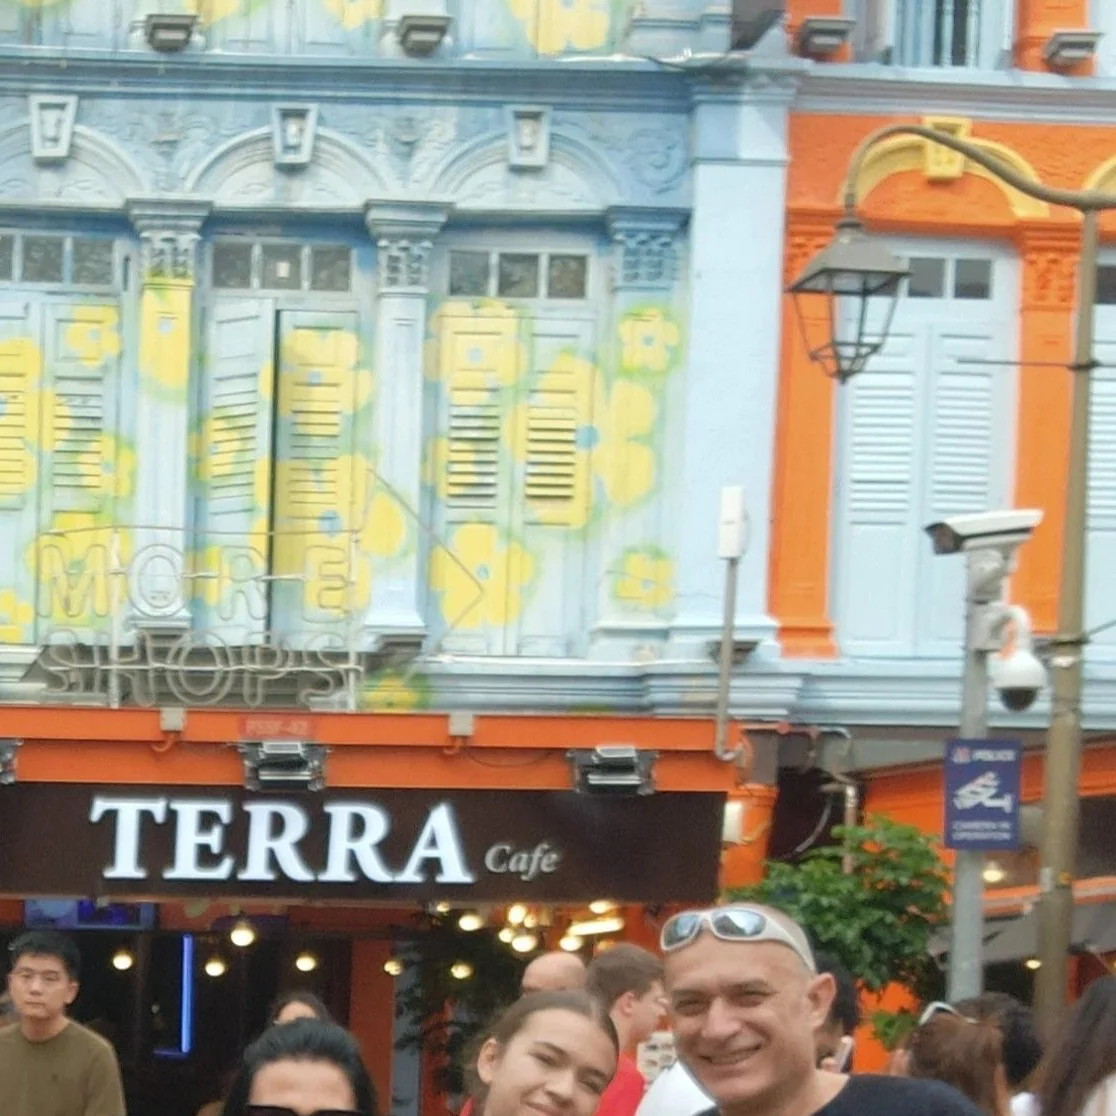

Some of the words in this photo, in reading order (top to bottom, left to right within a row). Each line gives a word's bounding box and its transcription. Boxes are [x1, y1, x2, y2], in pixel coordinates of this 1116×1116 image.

[35, 543, 351, 623] MORE
[38, 628, 348, 707] SHOPS
[90, 796, 476, 885] TERRA
[484, 840, 560, 882] Cafe
